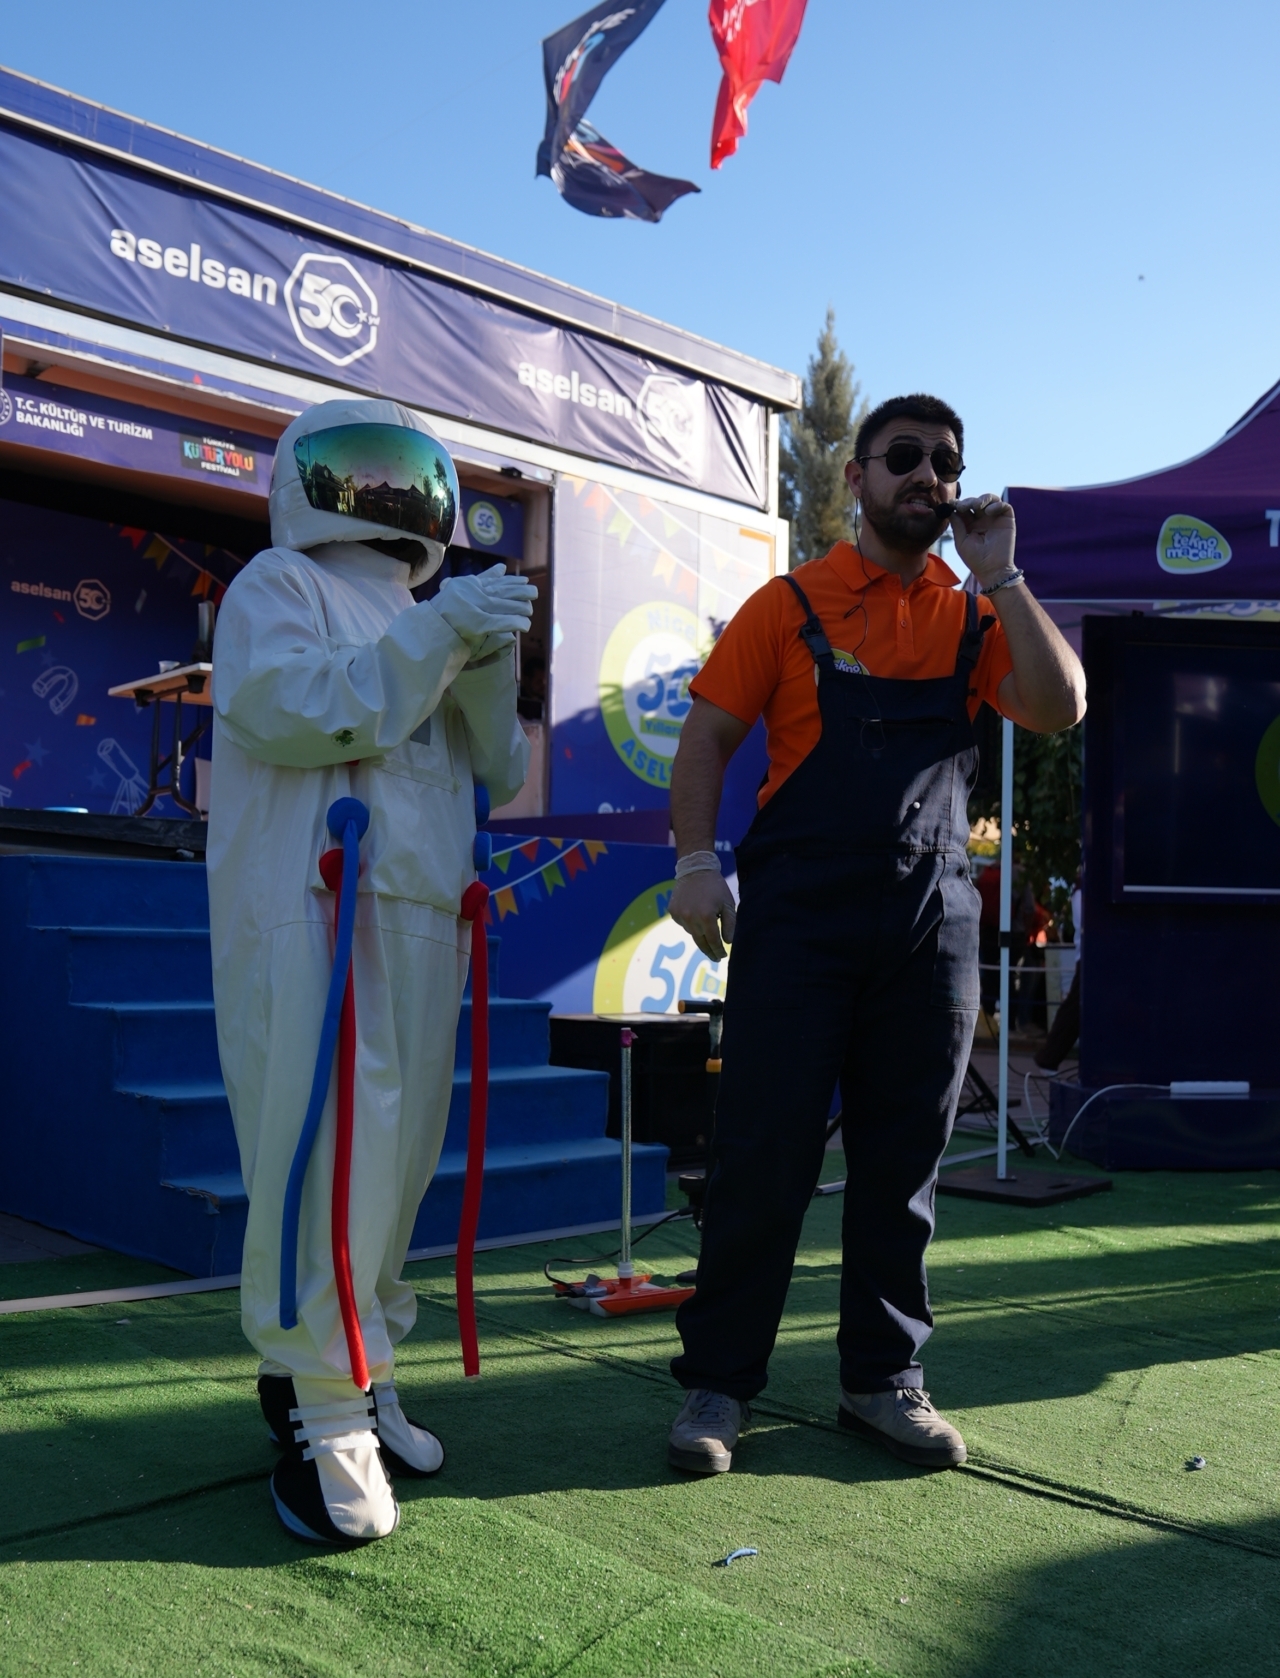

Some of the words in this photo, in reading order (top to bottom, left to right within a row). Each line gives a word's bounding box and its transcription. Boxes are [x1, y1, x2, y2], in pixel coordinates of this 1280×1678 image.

[110, 229, 277, 306] aselsan
[518, 361, 633, 419] aselsan
[15, 397, 38, 412] T.C.
[40, 402, 87, 425] KÜLTÜR
[90, 416, 105, 430] VE
[108, 420, 153, 440] TURİZM
[16, 410, 84, 438] BAKANLIĞI
[201, 461, 240, 477] FESTİVALİ
[1173, 529, 1217, 550] tekno
[1166, 547, 1222, 562] macera
[11, 581, 71, 602] aselsan
[647, 606, 696, 642] Nice
